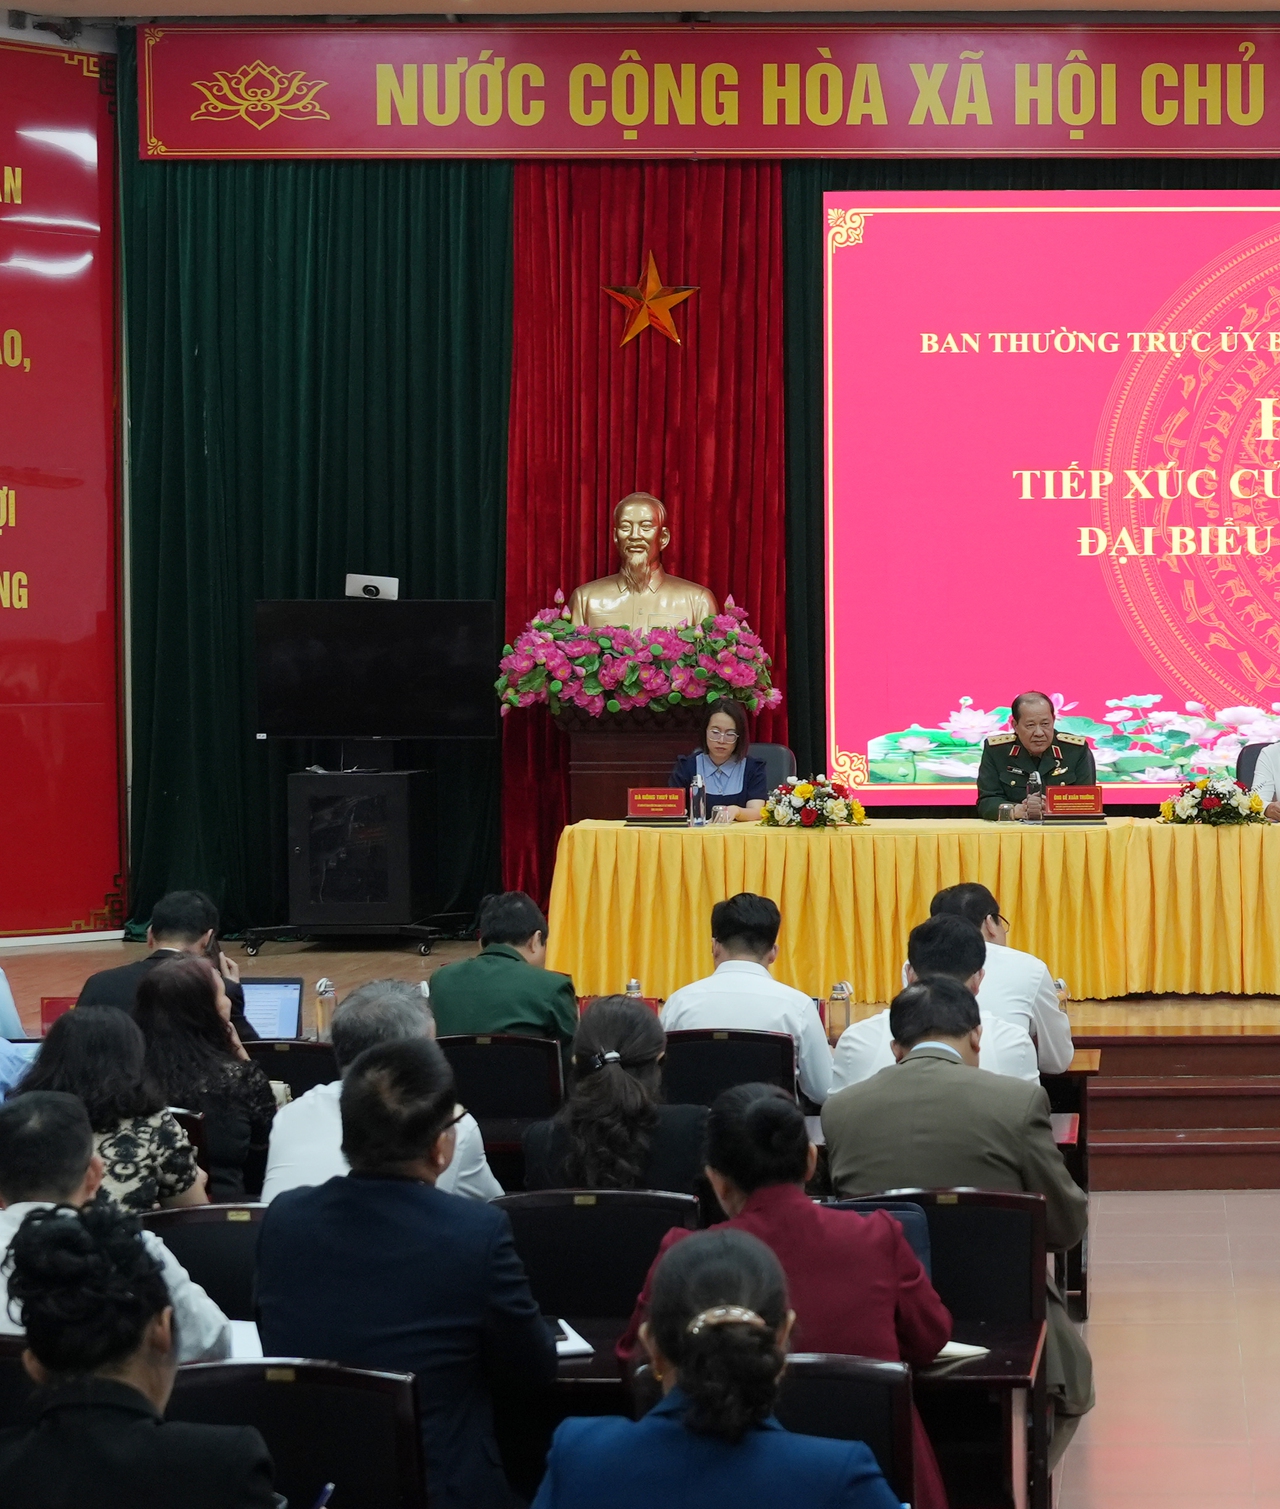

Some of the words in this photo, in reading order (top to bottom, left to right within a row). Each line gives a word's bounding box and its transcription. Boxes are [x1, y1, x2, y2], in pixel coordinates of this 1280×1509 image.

[376, 49, 546, 128] NƯỚC
[570, 50, 740, 140] CỘNG
[763, 47, 890, 127] HÒA
[908, 50, 996, 127] XÃ
[1015, 50, 1117, 140] HỘI
[1142, 42, 1266, 127] CHỦ
[0, 166, 22, 204] N
[0, 329, 31, 372] O,
[919, 333, 981, 354] BAN
[989, 327, 1120, 354] THƯỜNG
[1127, 328, 1212, 358] TRỰC
[1221, 325, 1262, 353] ỦY
[1012, 460, 1114, 501] TIẾP
[1123, 461, 1217, 500] XÚC
[1077, 525, 1157, 565] ĐẠI
[1170, 516, 1275, 557] BIỂU
